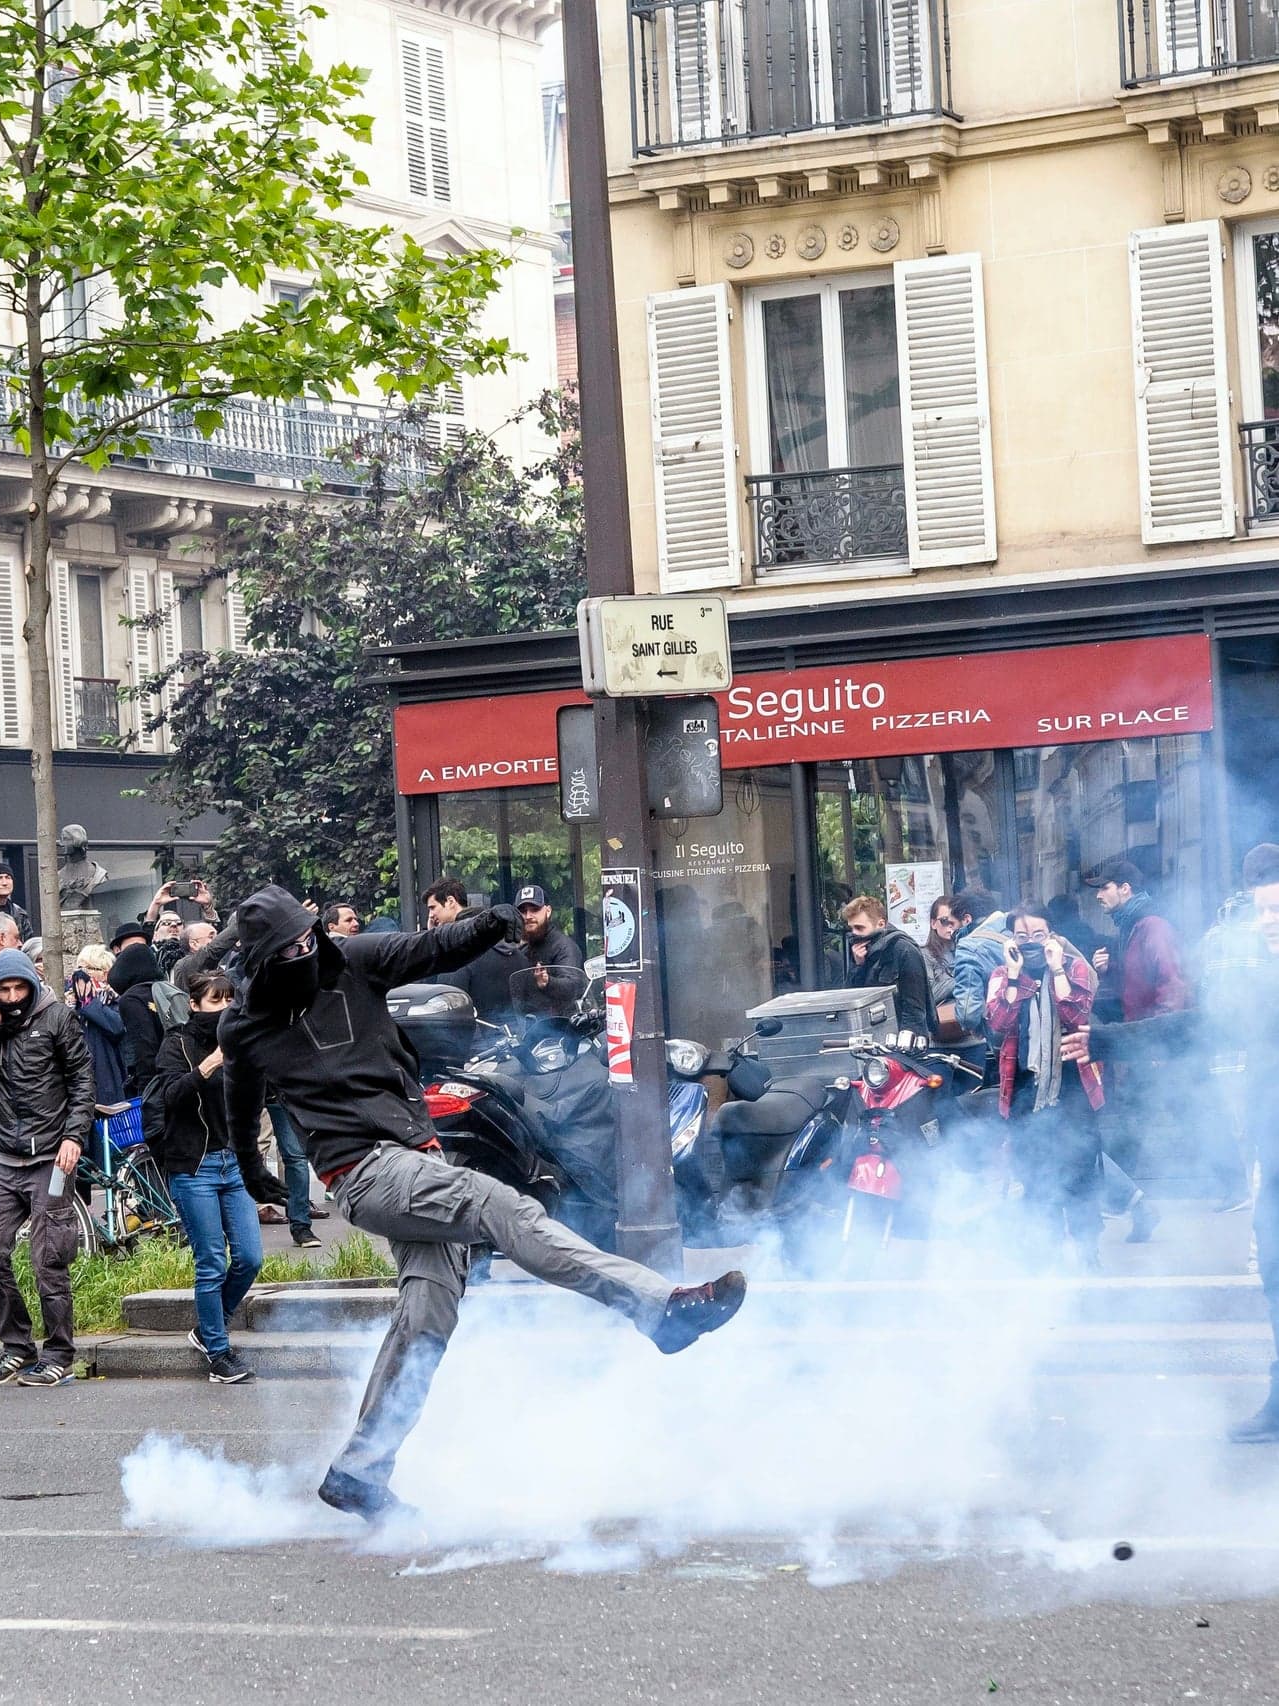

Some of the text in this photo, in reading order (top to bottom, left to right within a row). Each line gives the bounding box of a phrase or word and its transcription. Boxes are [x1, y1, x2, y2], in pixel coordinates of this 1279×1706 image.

[652, 615, 674, 630] RUE
[632, 641, 698, 657] SAINT GILLES
[727, 677, 886, 722] Seguito
[720, 720, 845, 743] TALIENNE
[872, 709, 991, 731] PIZZERIA
[1037, 706, 1189, 732] SUR PLACE
[418, 757, 557, 782] A EMPORTE
[675, 841, 744, 858] Il Seguito
[601, 873, 637, 885] ENSUEL
[652, 864, 771, 878] CUISINE ITALIENNE PIZZERIA
